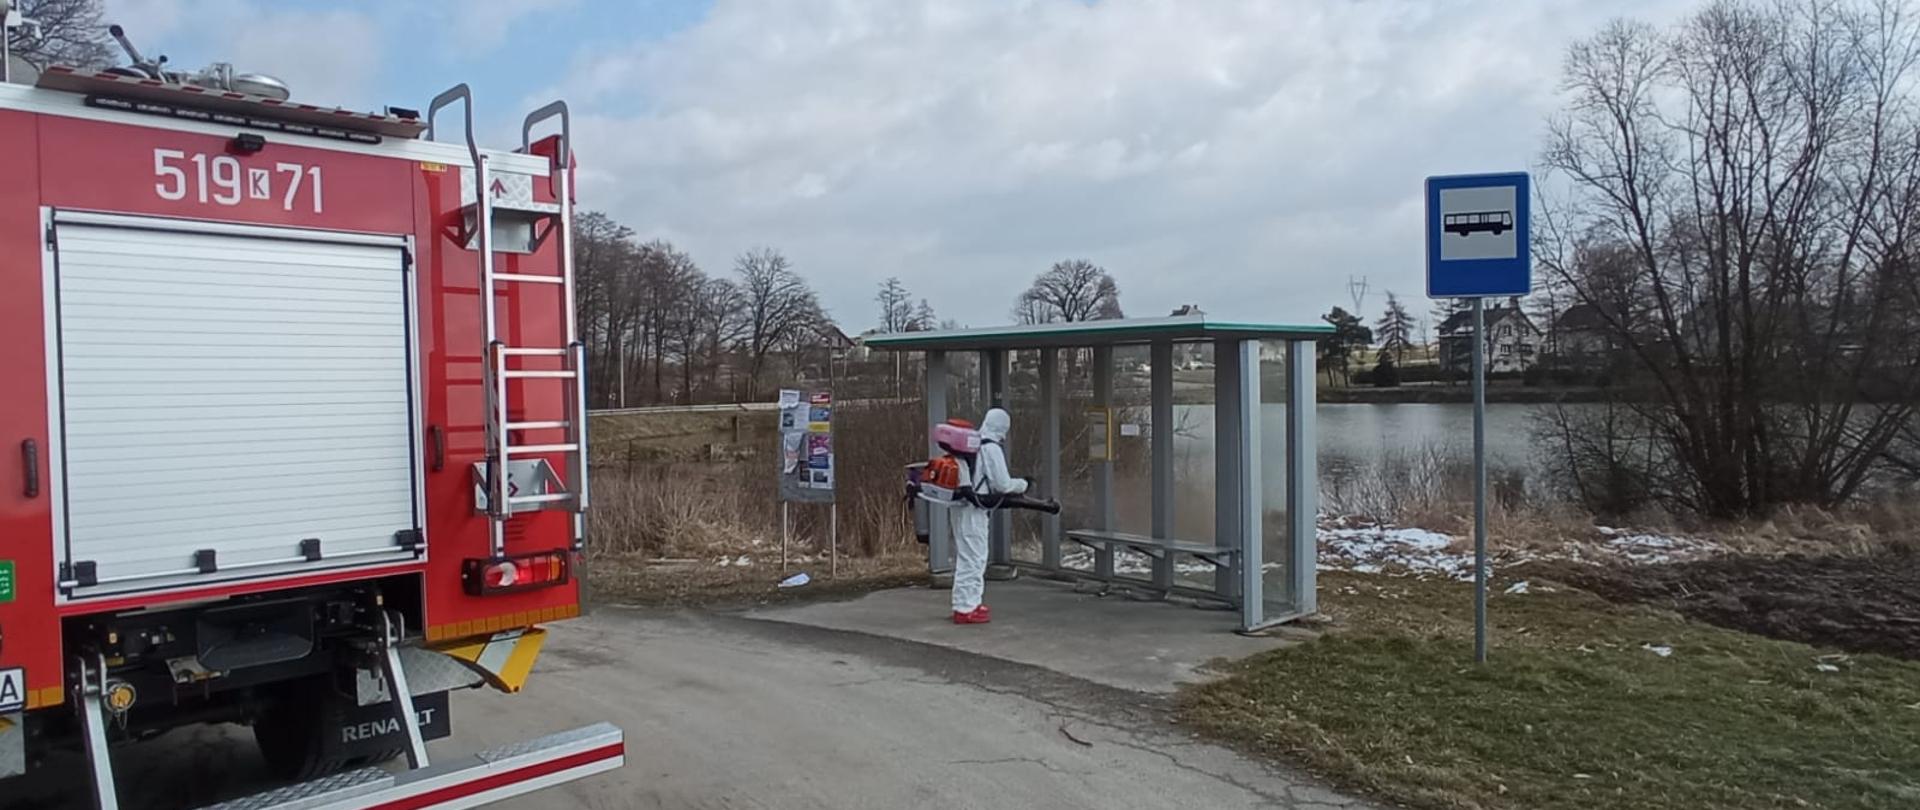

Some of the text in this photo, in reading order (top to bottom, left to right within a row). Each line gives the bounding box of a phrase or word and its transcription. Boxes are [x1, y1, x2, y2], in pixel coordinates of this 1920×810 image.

[153, 147, 323, 214] 519 K 71
[341, 707, 435, 743] RENALT
